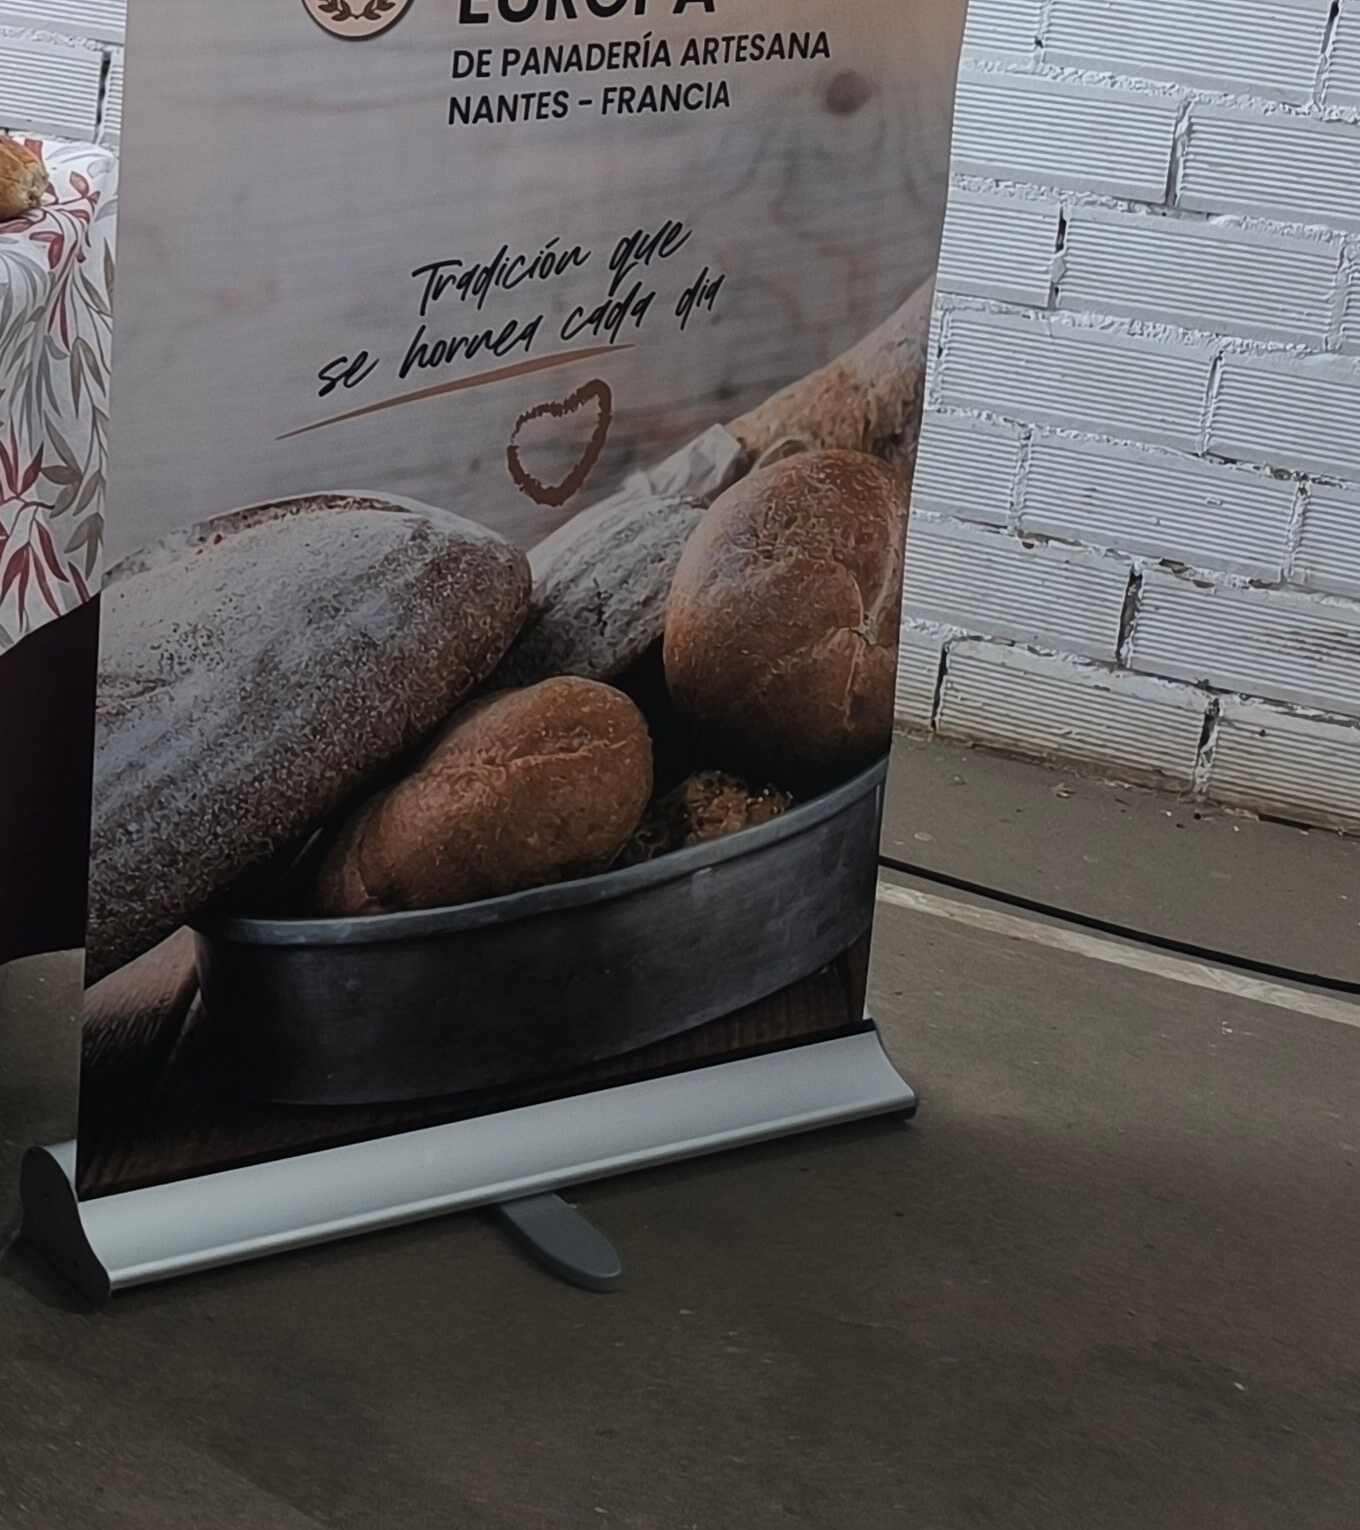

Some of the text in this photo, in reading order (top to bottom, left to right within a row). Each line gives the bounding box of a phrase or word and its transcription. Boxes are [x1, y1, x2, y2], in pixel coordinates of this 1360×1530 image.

[451, 32, 830, 79] DE PANADERÍA ARTESANA
[448, 90, 569, 125] NANTES
[601, 80, 731, 115] FRANCIA
[412, 220, 691, 316] Tradición que
[317, 352, 380, 398] se
[399, 314, 544, 380] hornea
[561, 280, 658, 344] cada
